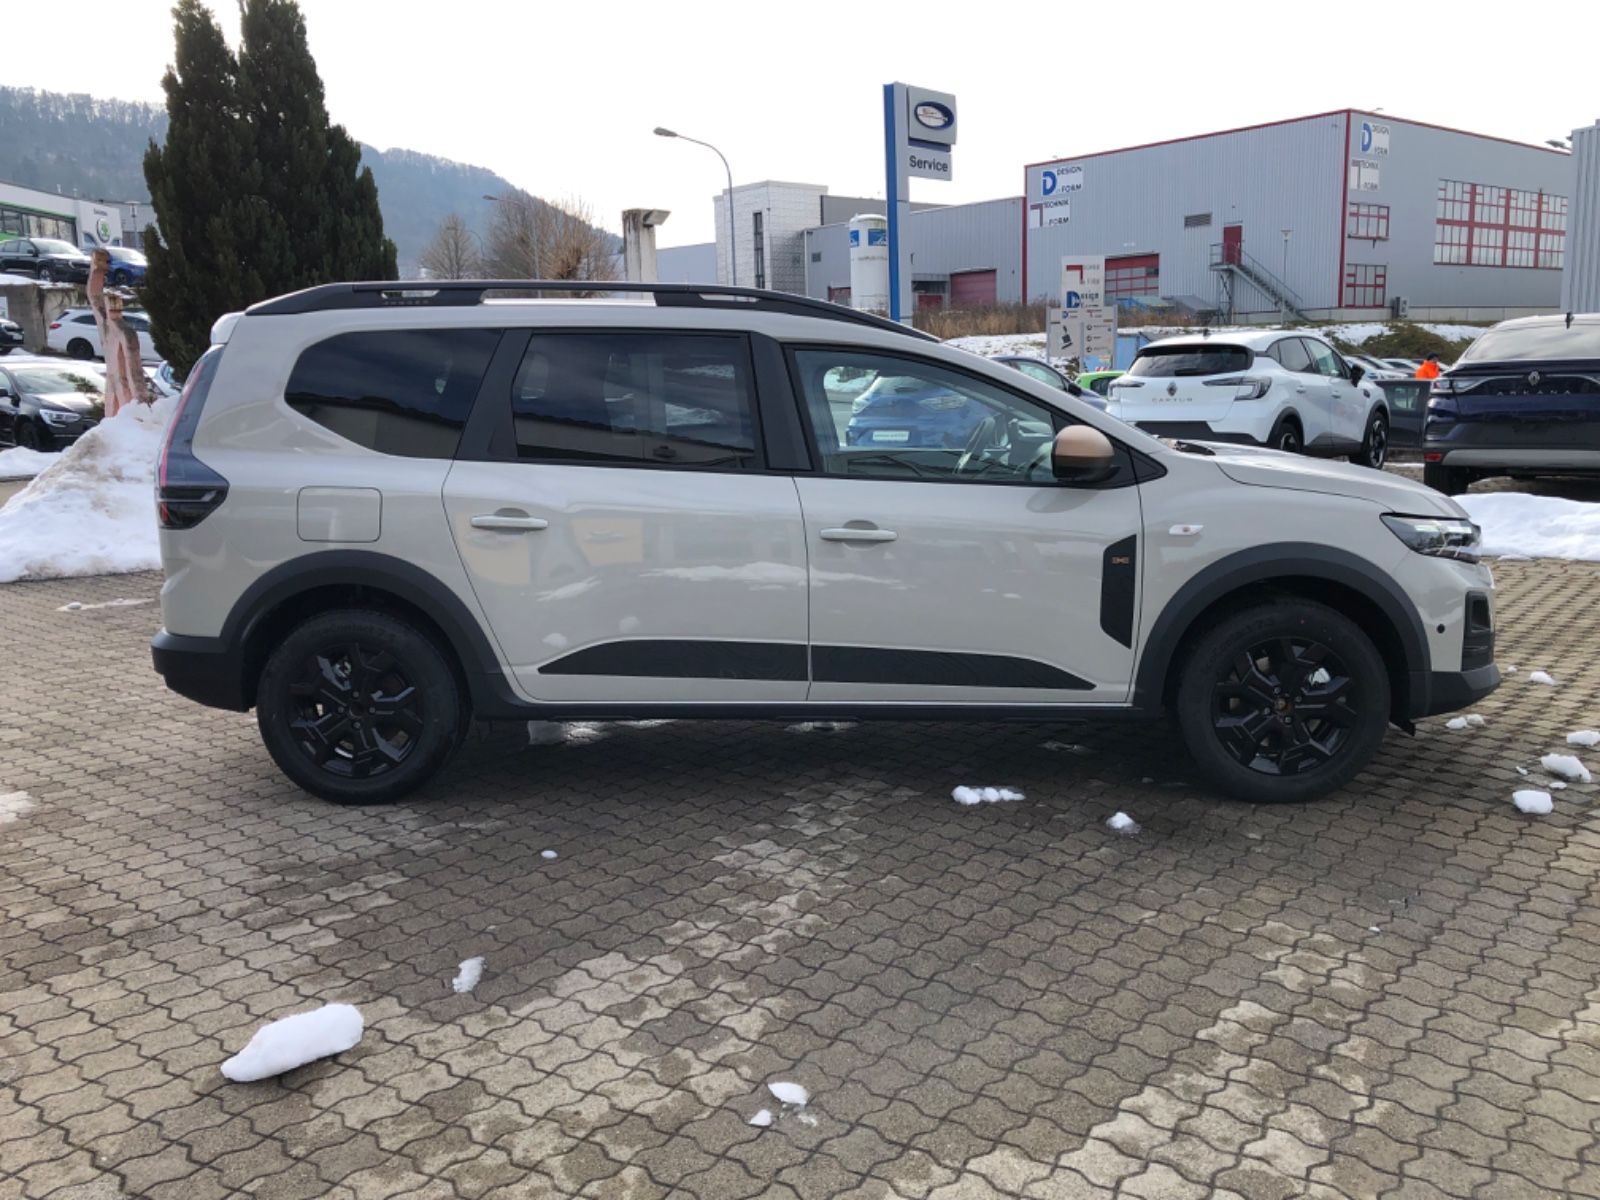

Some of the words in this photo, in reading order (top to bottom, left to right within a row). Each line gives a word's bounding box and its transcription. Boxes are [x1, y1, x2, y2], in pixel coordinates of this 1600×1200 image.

[909, 155, 949, 172] Service
[1056, 166, 1082, 176] DESIGN
[1061, 184, 1082, 193] FORM
